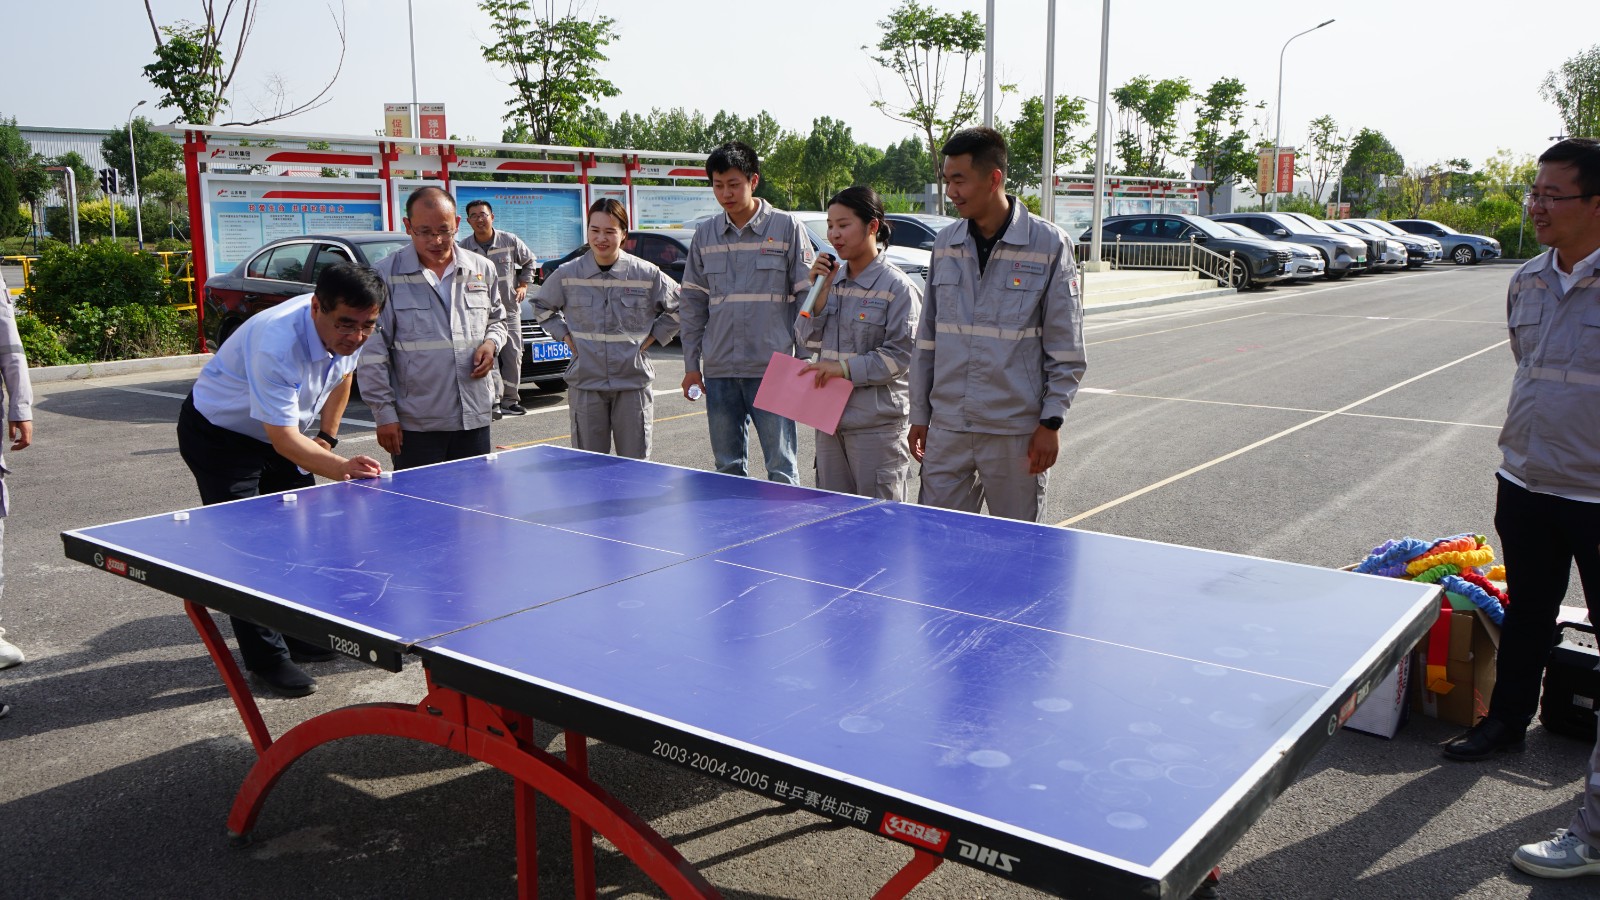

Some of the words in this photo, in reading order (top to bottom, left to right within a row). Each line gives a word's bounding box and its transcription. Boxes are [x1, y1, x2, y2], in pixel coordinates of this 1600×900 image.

[129, 566, 147, 581] DHS
[328, 634, 360, 658] T2828
[773, 780, 871, 825] 世乒赛供应商
[882, 815, 943, 846] 红双喜
[957, 838, 1021, 873] DHS
